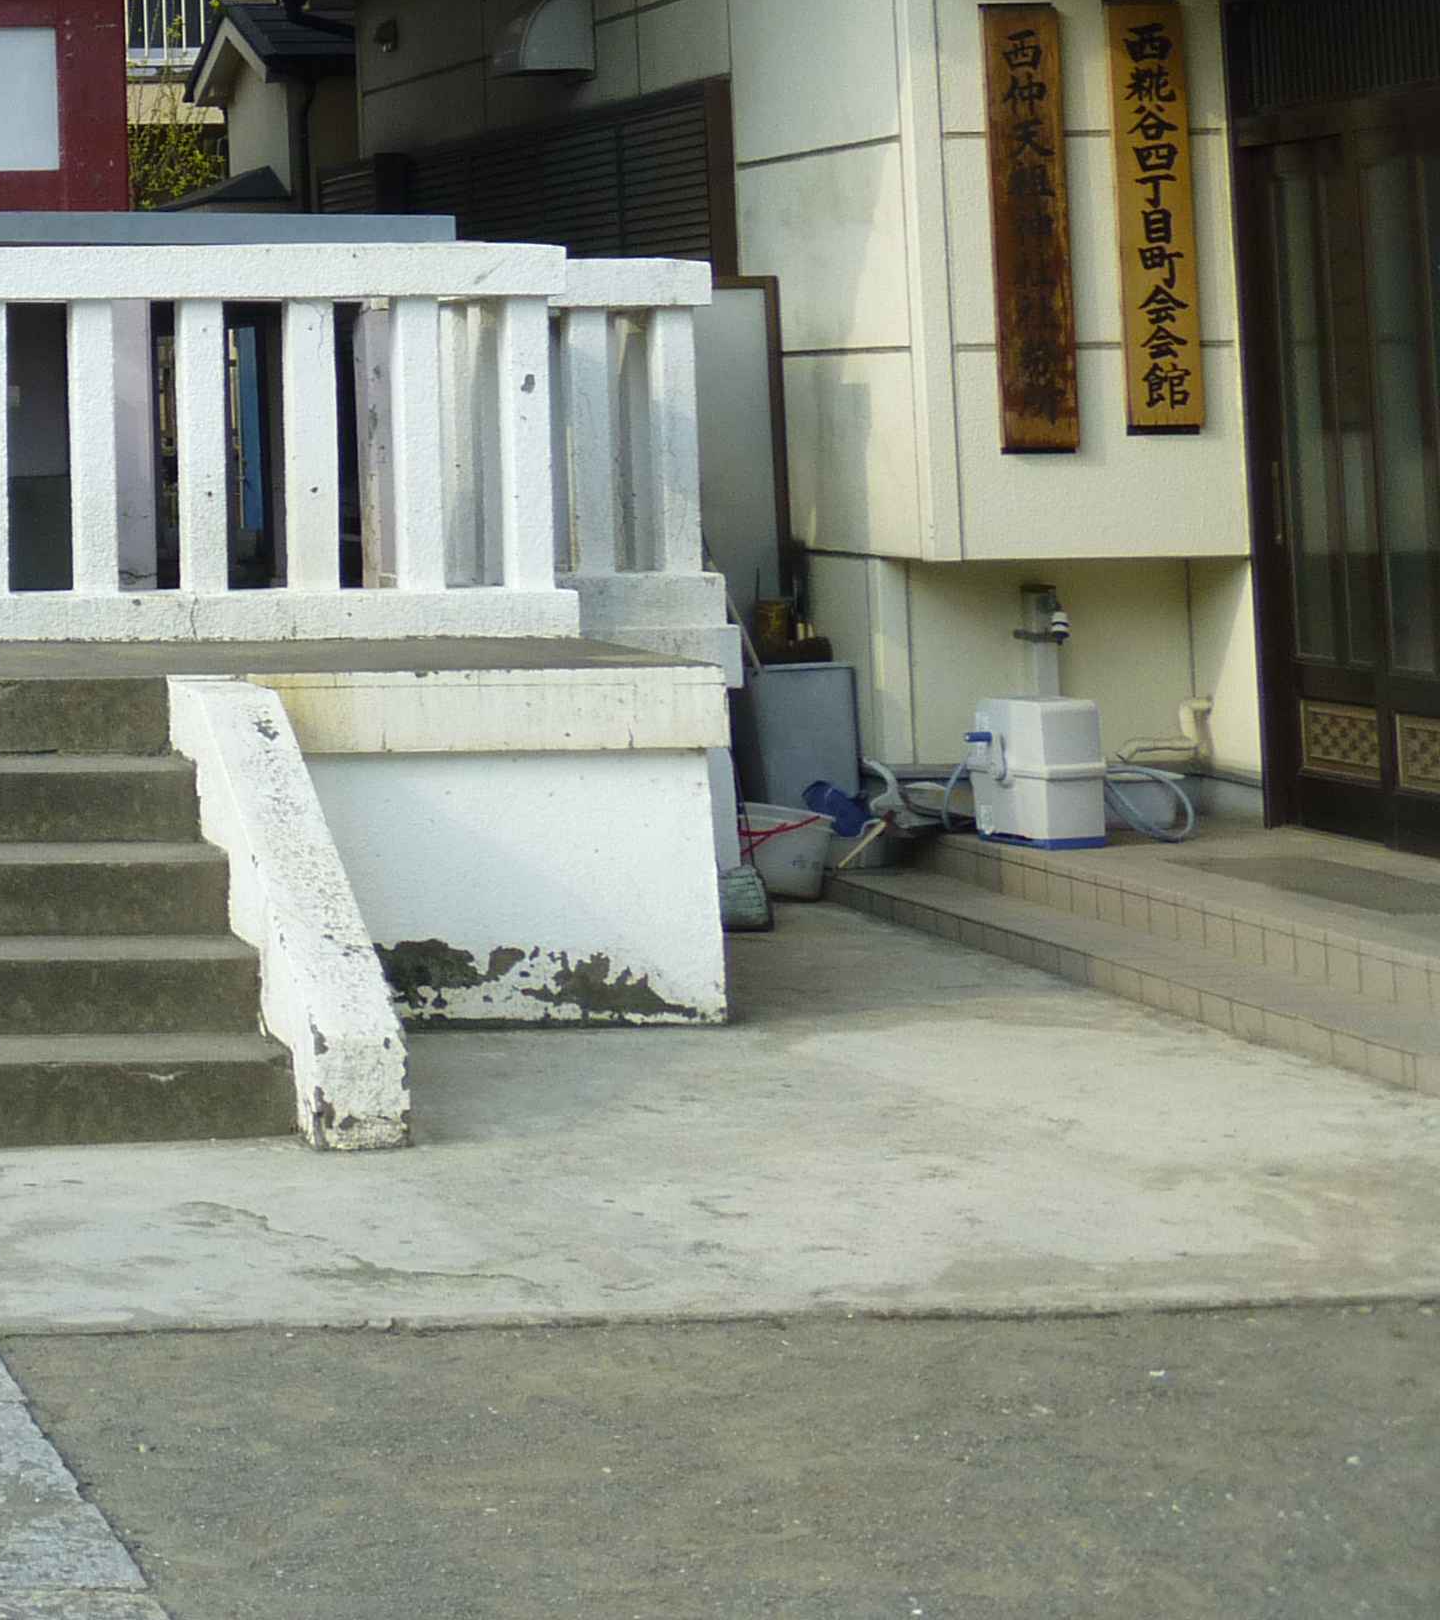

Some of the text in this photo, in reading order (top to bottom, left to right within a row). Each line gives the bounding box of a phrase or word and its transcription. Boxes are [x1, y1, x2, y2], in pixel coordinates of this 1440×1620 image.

[1123, 22, 1190, 410] 西糀谷四丁目町会会館
